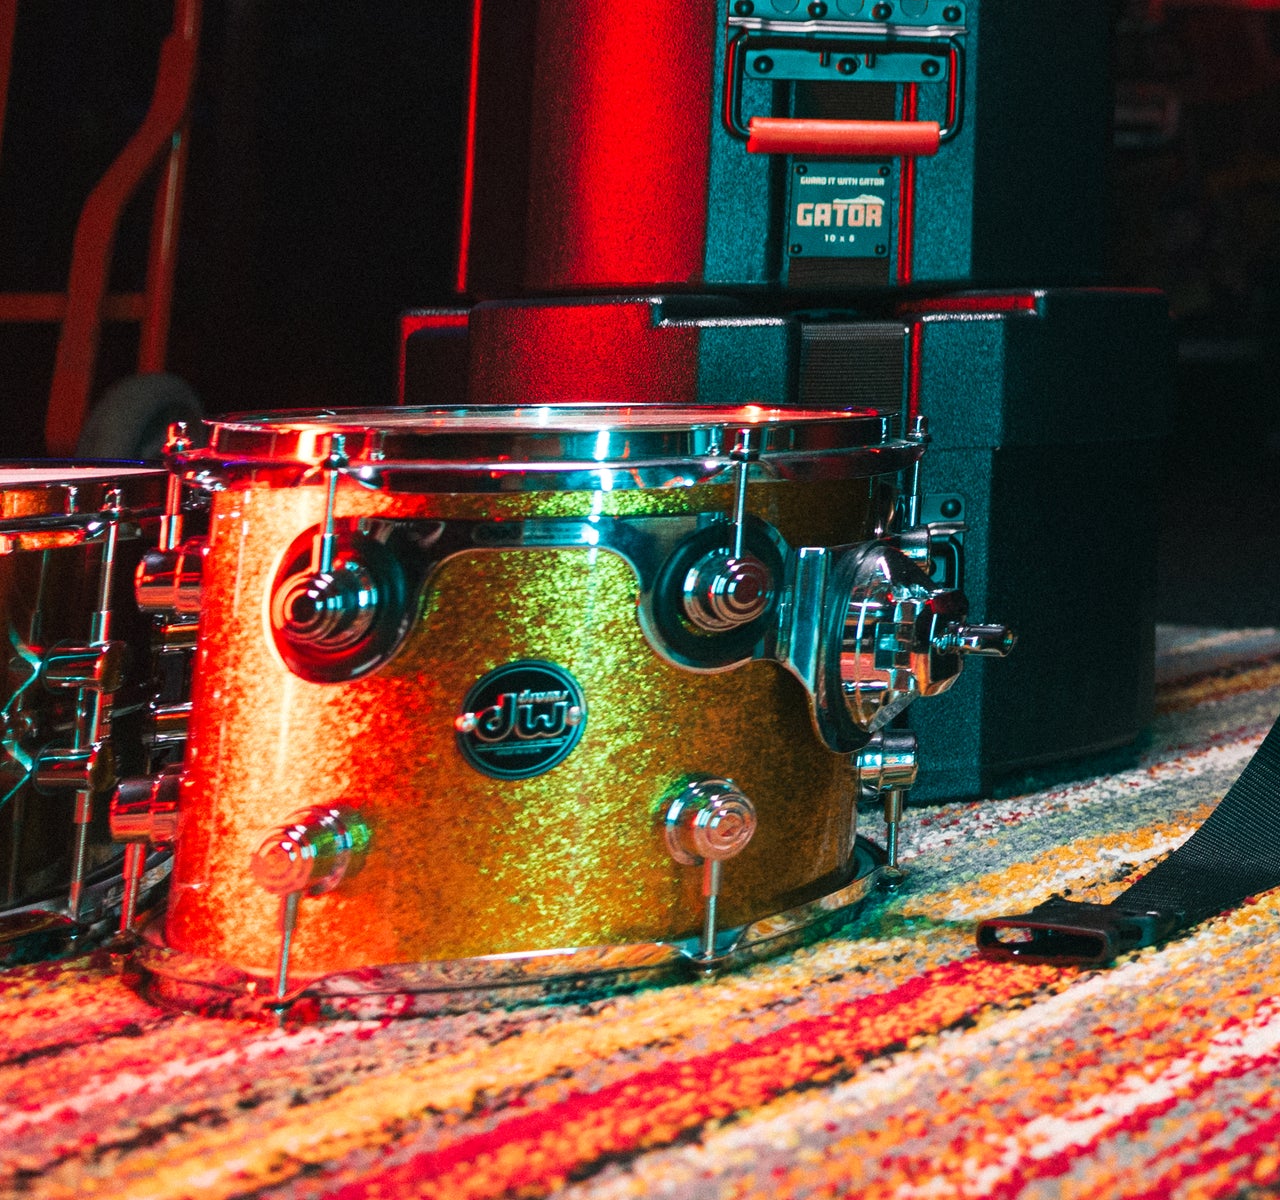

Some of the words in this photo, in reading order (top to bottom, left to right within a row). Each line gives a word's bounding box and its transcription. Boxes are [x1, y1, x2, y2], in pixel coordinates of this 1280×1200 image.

[800, 176, 827, 186] GUARD
[828, 176, 836, 186] IT
[837, 177, 858, 187] WITH
[859, 177, 885, 187] GATOR
[796, 202, 883, 228] GATOR
[473, 692, 569, 743] dw
